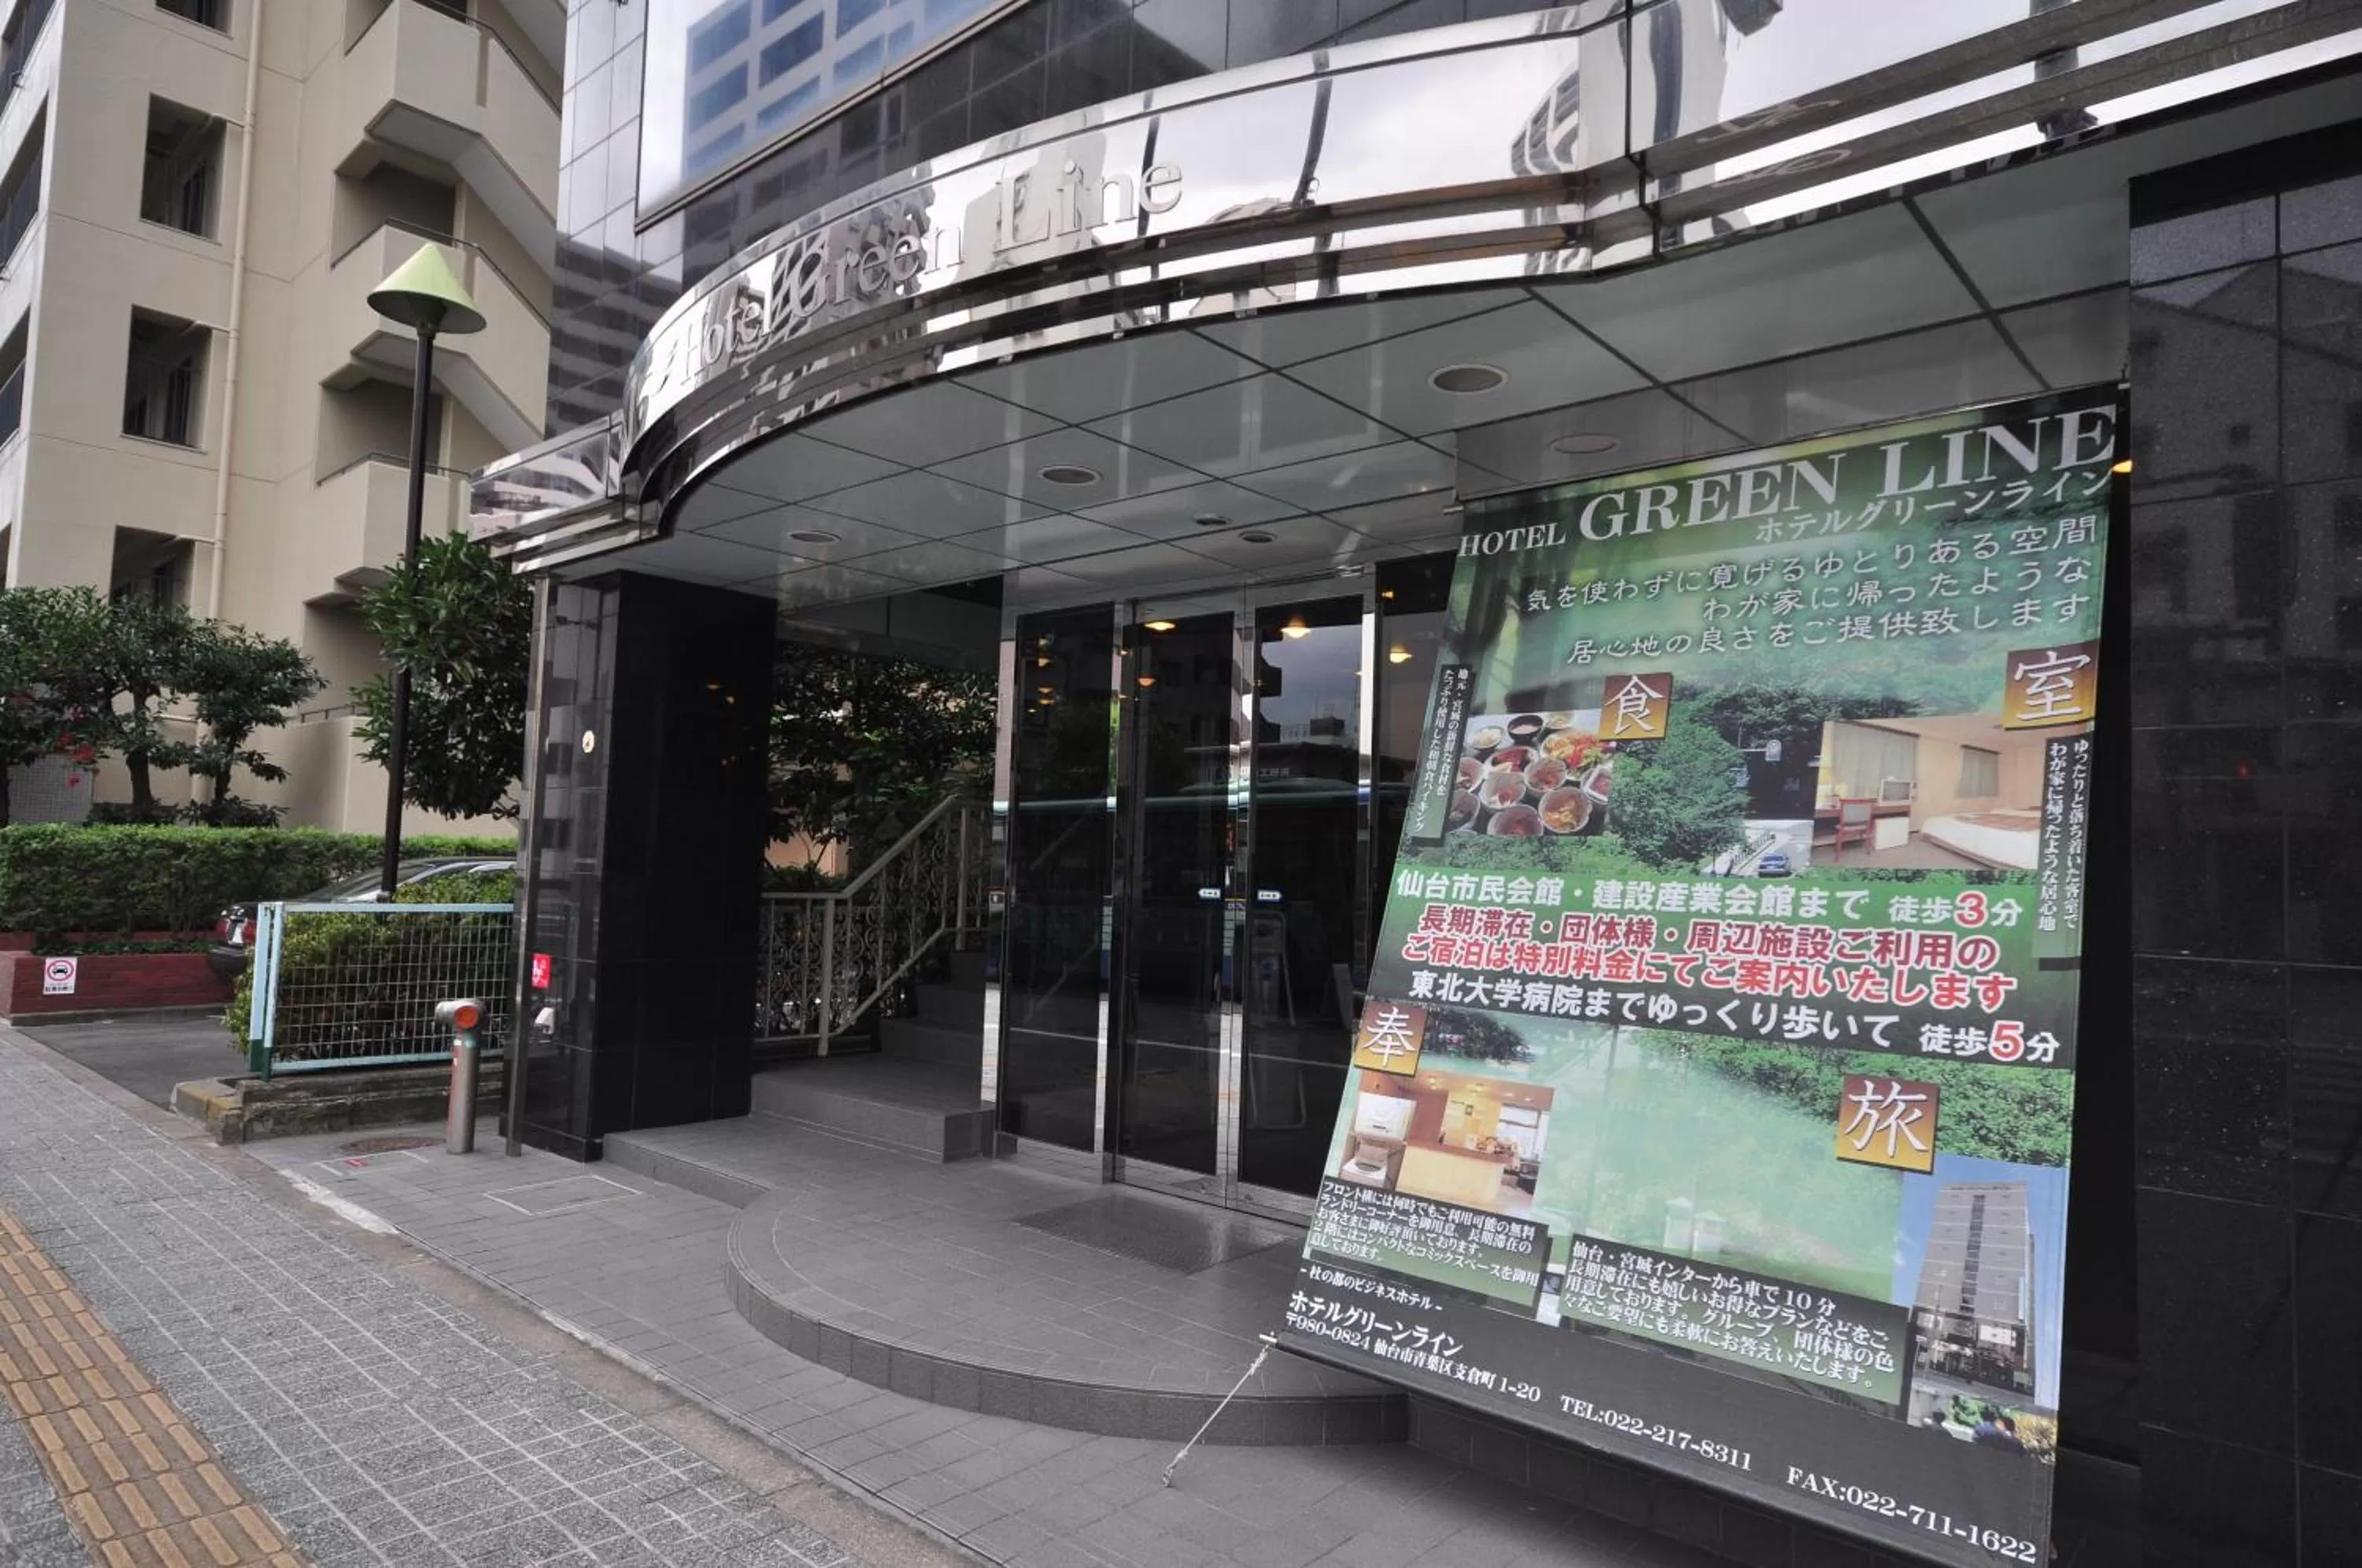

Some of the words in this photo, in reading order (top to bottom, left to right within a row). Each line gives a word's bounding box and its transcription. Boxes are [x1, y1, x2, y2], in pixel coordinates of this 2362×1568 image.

[679, 272, 773, 386] Hotel
[789, 226, 965, 317] Green
[994, 160, 1183, 254] Line
[1457, 522, 1567, 557] HOTEL
[1579, 453, 1847, 542] GREEN
[1876, 403, 2117, 497] LINE
[1755, 468, 2113, 544] ホテルグリーンライン
[1527, 515, 2097, 612] 気を使わずに寛げるゆとりある空間
[1702, 556, 2092, 621] わが家に帰ったような
[1567, 594, 2090, 666] 居心地の良さをご提供致します
[1604, 675, 1664, 735] 食
[2013, 649, 2092, 722] 室
[1397, 868, 1871, 919] 仙台市民会館・建設産業会館まで
[1889, 889, 2023, 929] 徒歩3分
[1401, 934, 2017, 1013] ご宿泊は特別料金にてご案内いたします
[1417, 904, 2000, 972] 長期滞在・団体様・周辺施設ご利用の
[1362, 1006, 1416, 1067] 奉
[1408, 970, 1900, 1048] 東北大学病院までゆっくり歩いて
[1919, 1020, 2061, 1063] 徒歩5分
[1844, 1078, 1929, 1158] 旅
[1289, 1290, 1464, 1357] ホテルグリーンライン
[1560, 1393, 1753, 1474] TEL:022-217-8311
[1785, 1466, 2039, 1564] FAX:022-711-1622
